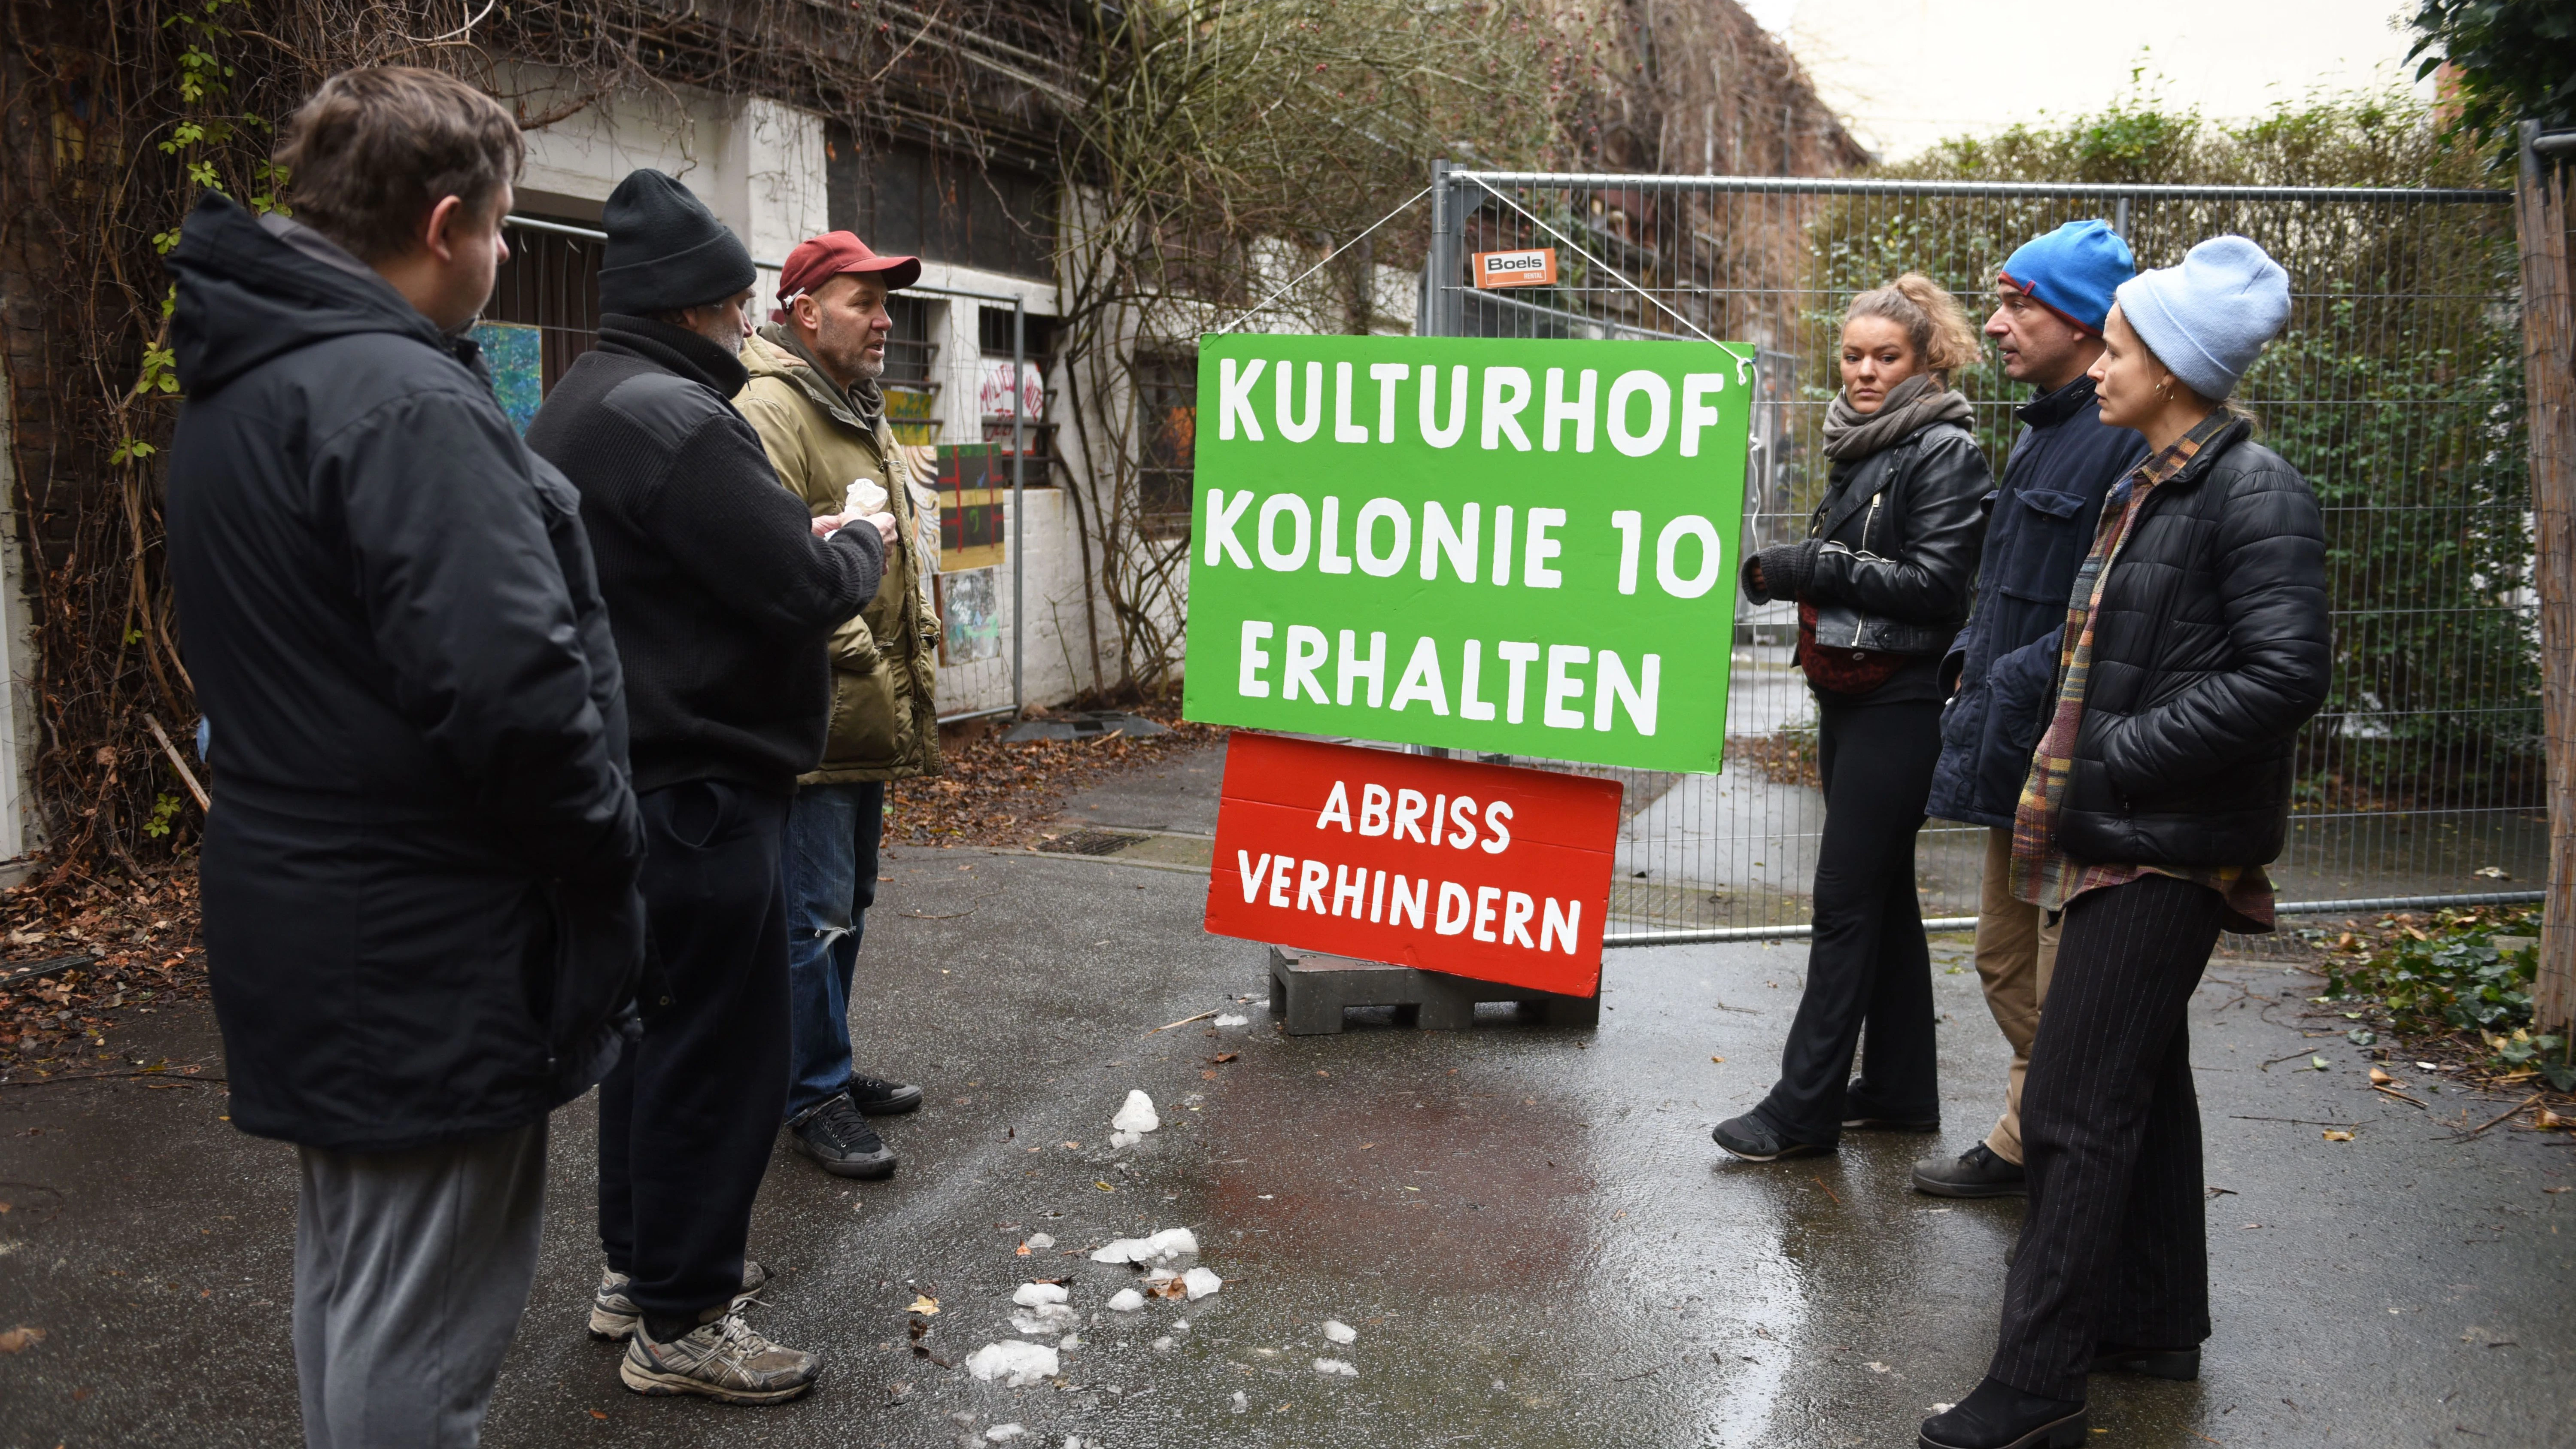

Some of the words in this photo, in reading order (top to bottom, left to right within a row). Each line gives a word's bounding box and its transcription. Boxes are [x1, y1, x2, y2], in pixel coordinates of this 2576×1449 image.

[1487, 256, 1542, 271] Boels
[1218, 358, 1725, 458] KULTURHOF
[1203, 488, 1567, 589] KOLONIE
[1611, 510, 1722, 599] 10
[1238, 620, 1662, 737] ERHALTEN
[1315, 780, 1514, 854] ABRISS
[1237, 849, 1582, 956] VERHINDERN
